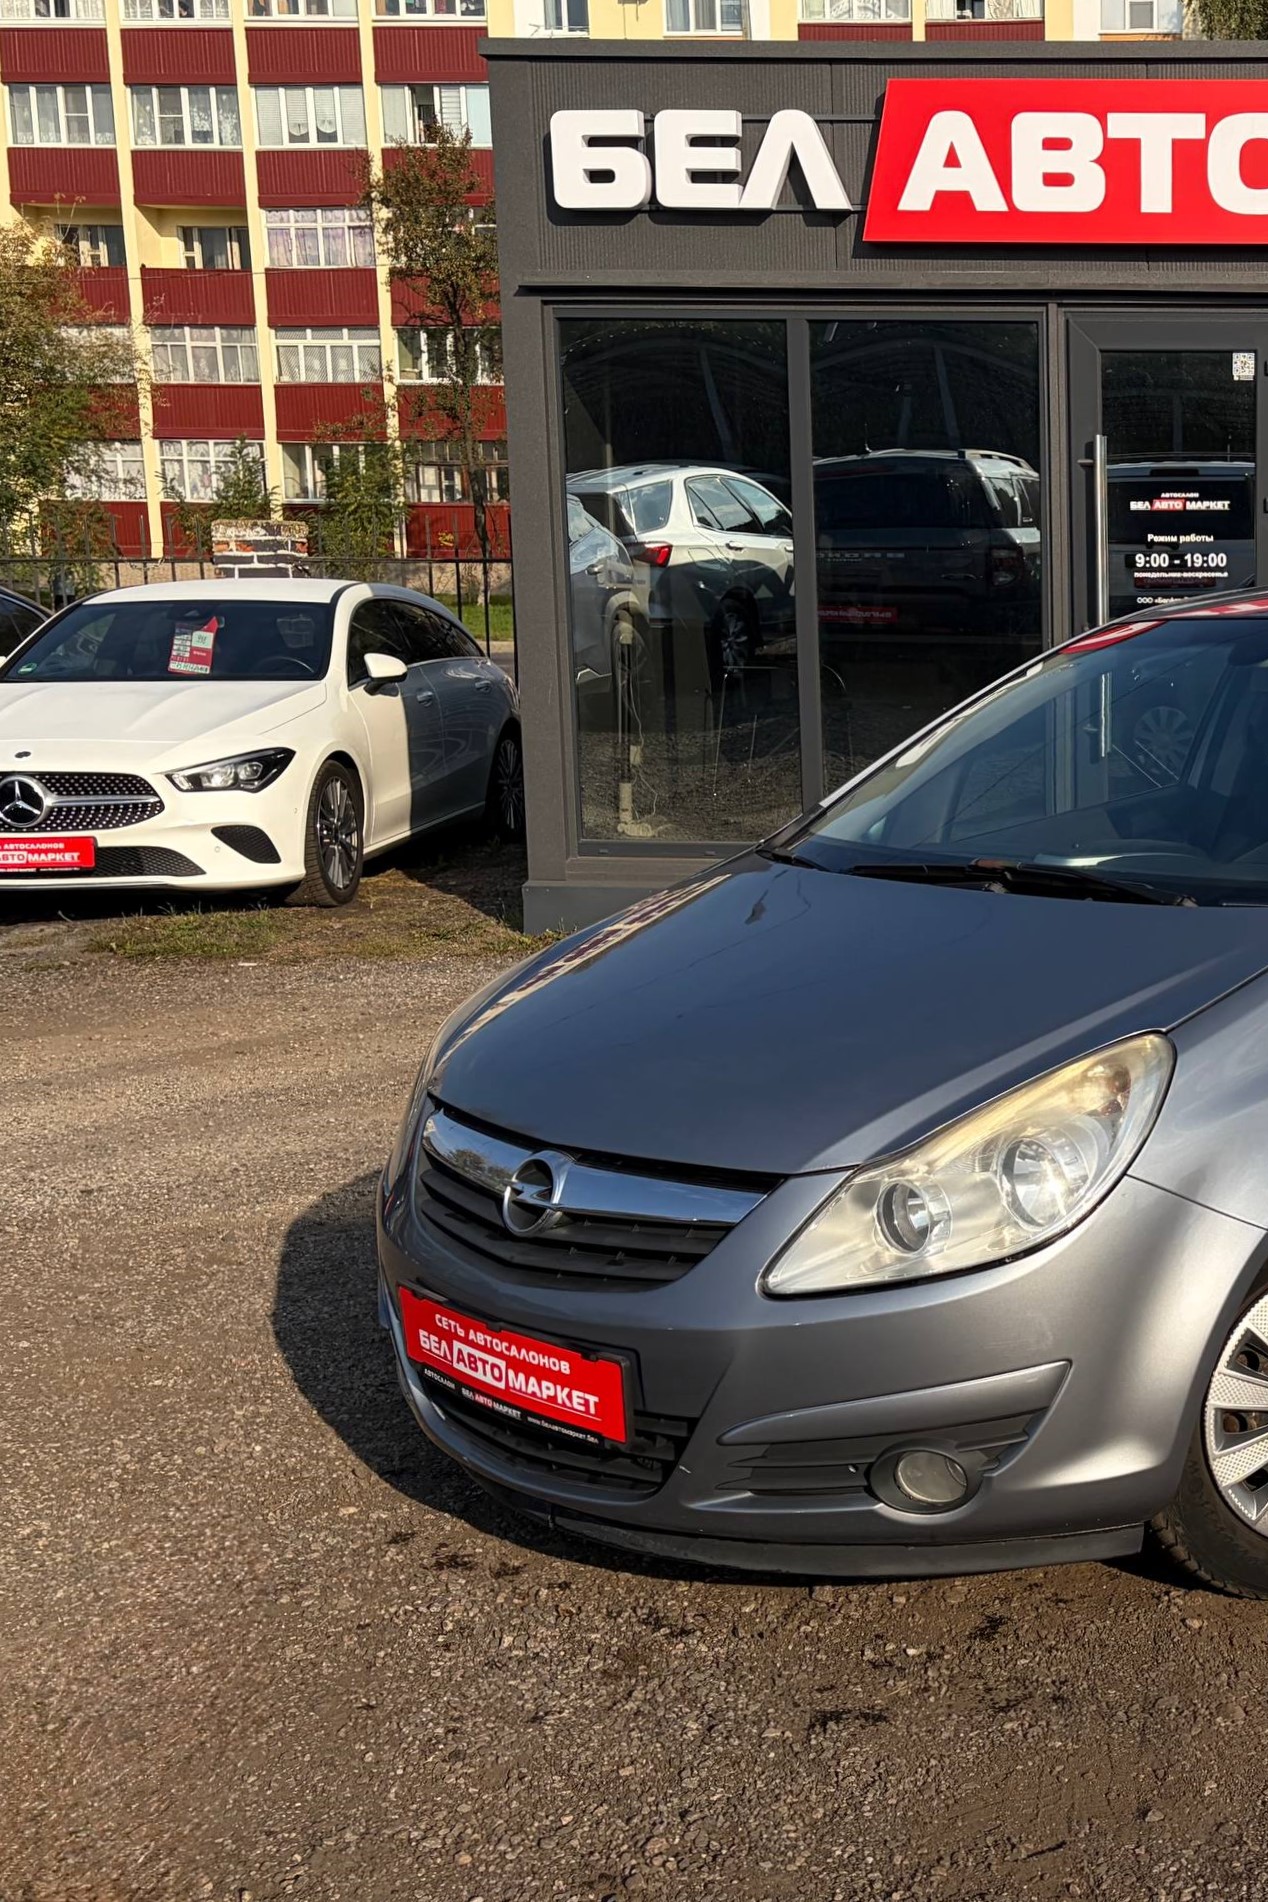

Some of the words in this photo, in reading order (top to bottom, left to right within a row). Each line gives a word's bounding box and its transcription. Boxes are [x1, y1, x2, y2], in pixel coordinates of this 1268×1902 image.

[549, 109, 852, 211] БЕЛ
[1130, 501, 1151, 510] БЕЛ
[1154, 501, 1183, 510] АВТО
[1186, 501, 1231, 510] МАРКЕТ
[1147, 533, 1178, 542] Режим
[1179, 533, 1214, 544] работы
[1135, 553, 1170, 567] 9:00
[1184, 553, 1228, 567] 19:00
[28, 852, 80, 862] МАРКЕТ
[435, 1313, 465, 1337] СЕТЬ
[468, 1328, 571, 1375] АВТОСАЛОНОВ
[418, 1328, 451, 1361] БЕЛ
[455, 1348, 502, 1384] АВТО
[507, 1368, 600, 1415] МАРКЕТ
[474, 1393, 493, 1408] АВТО
[493, 1401, 522, 1419] МАРКЕТ
